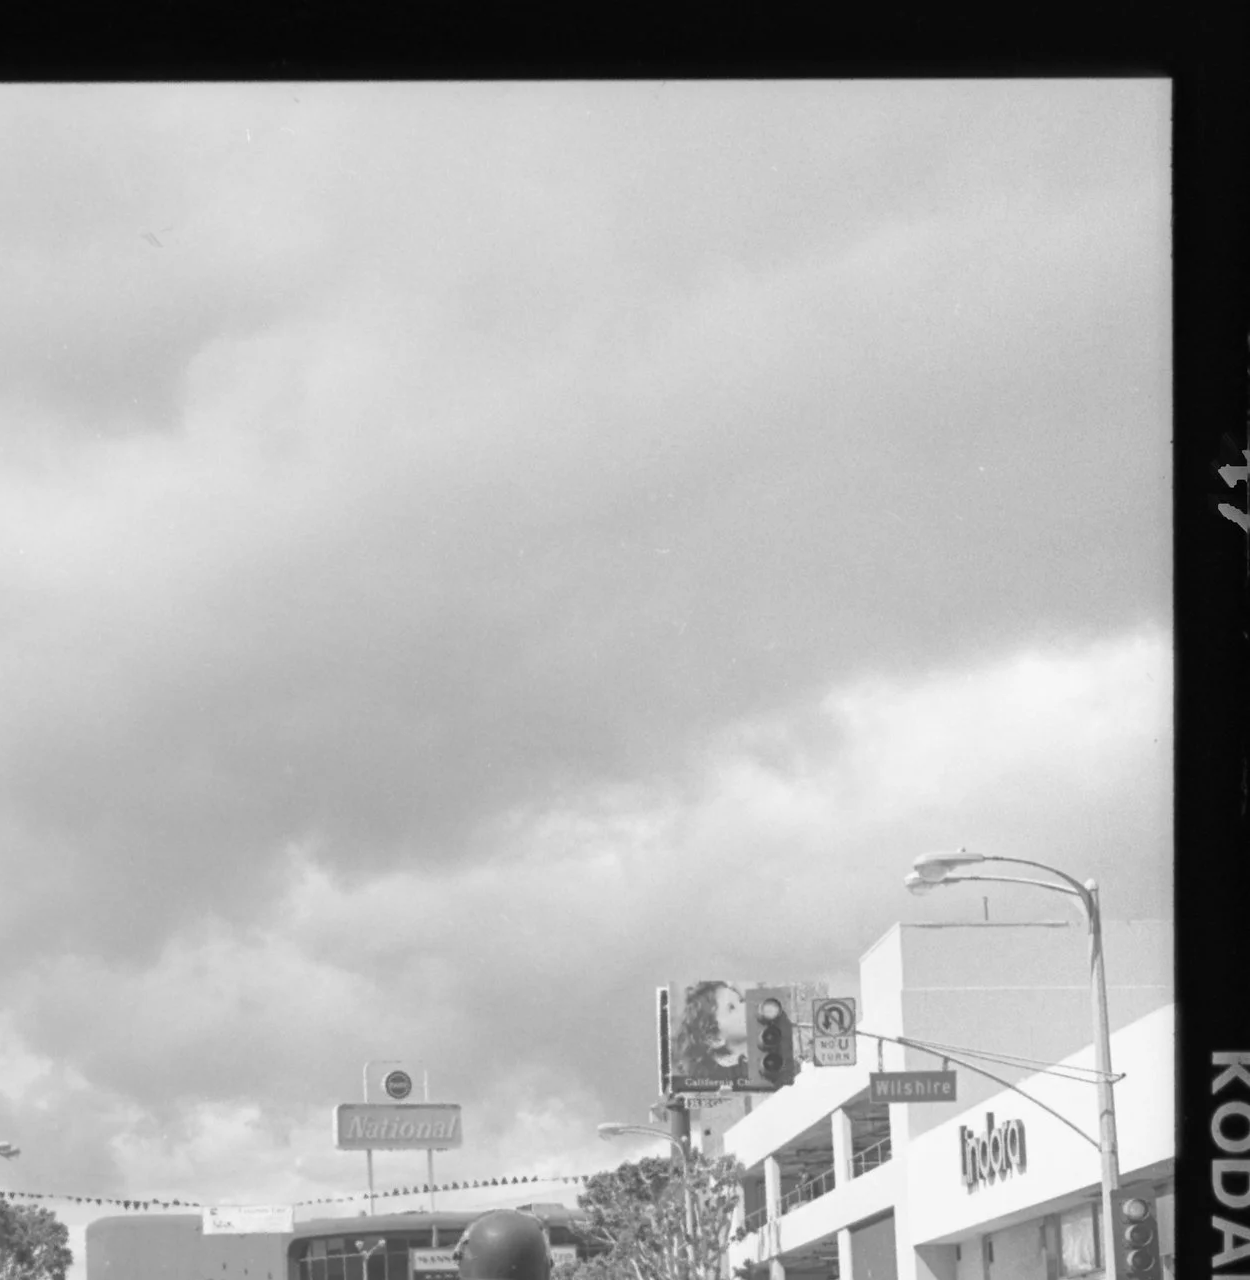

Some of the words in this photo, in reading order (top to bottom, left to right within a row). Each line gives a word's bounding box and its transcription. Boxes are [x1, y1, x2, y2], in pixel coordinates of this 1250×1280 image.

[821, 1040, 835, 1049] NO
[838, 1038, 849, 1051] U
[821, 1053, 850, 1061] TURN
[685, 1078, 734, 1087] California
[875, 1080, 951, 1096] Wilshire
[347, 1115, 457, 1140] National
